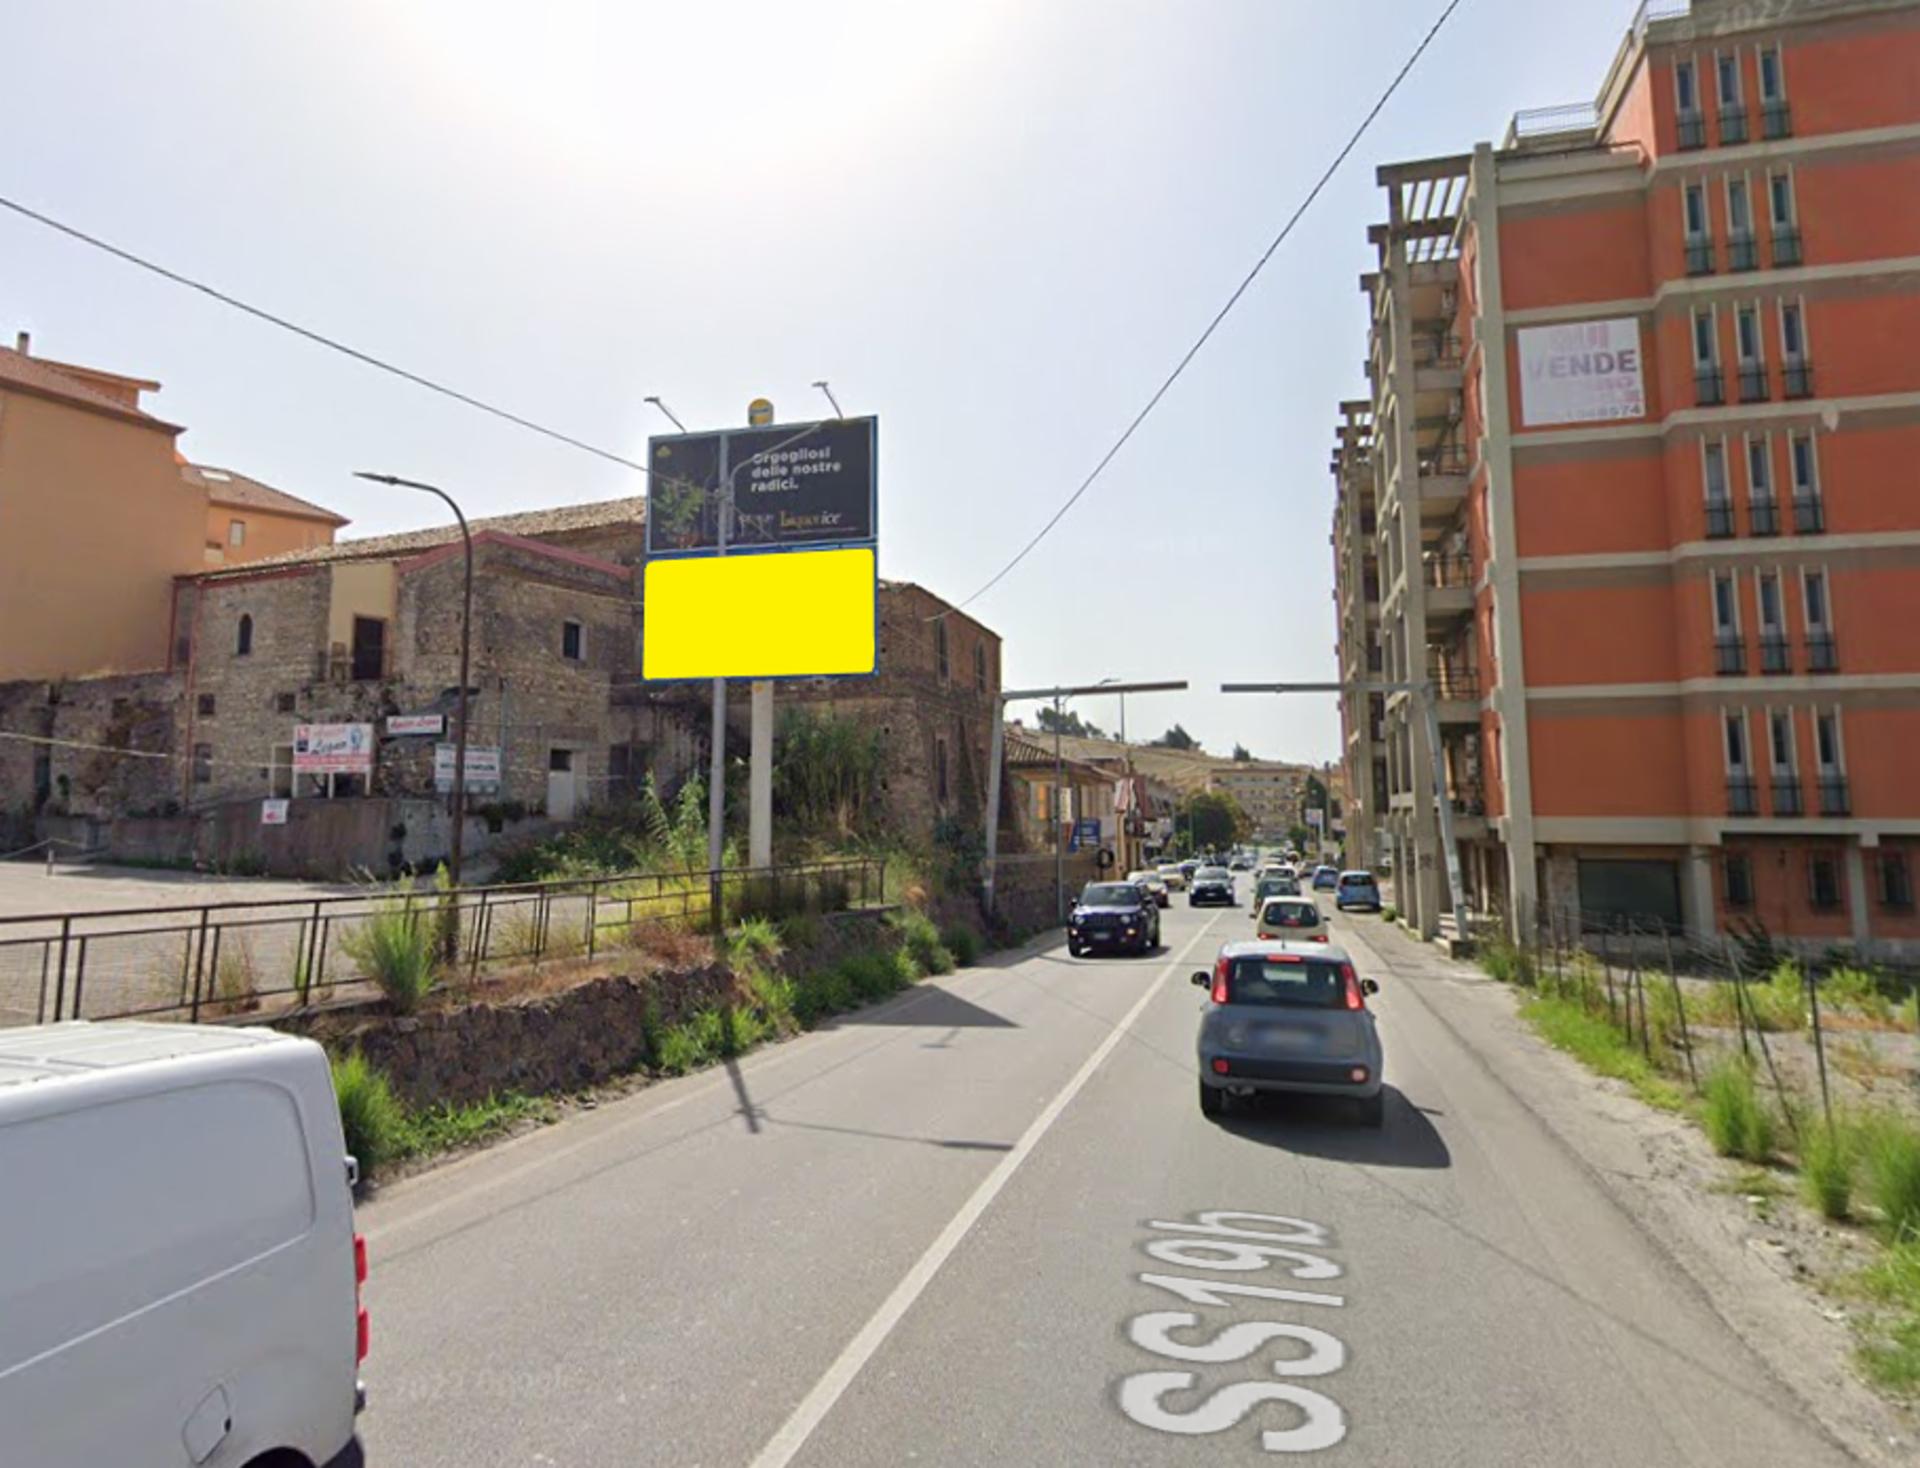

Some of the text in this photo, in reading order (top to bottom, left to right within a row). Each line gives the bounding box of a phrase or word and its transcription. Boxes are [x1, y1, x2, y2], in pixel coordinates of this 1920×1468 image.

[1527, 349, 1638, 381] VENDE
[752, 447, 831, 464] Orgogliosi
[752, 461, 842, 478] delle nostre
[751, 477, 799, 492] radici.
